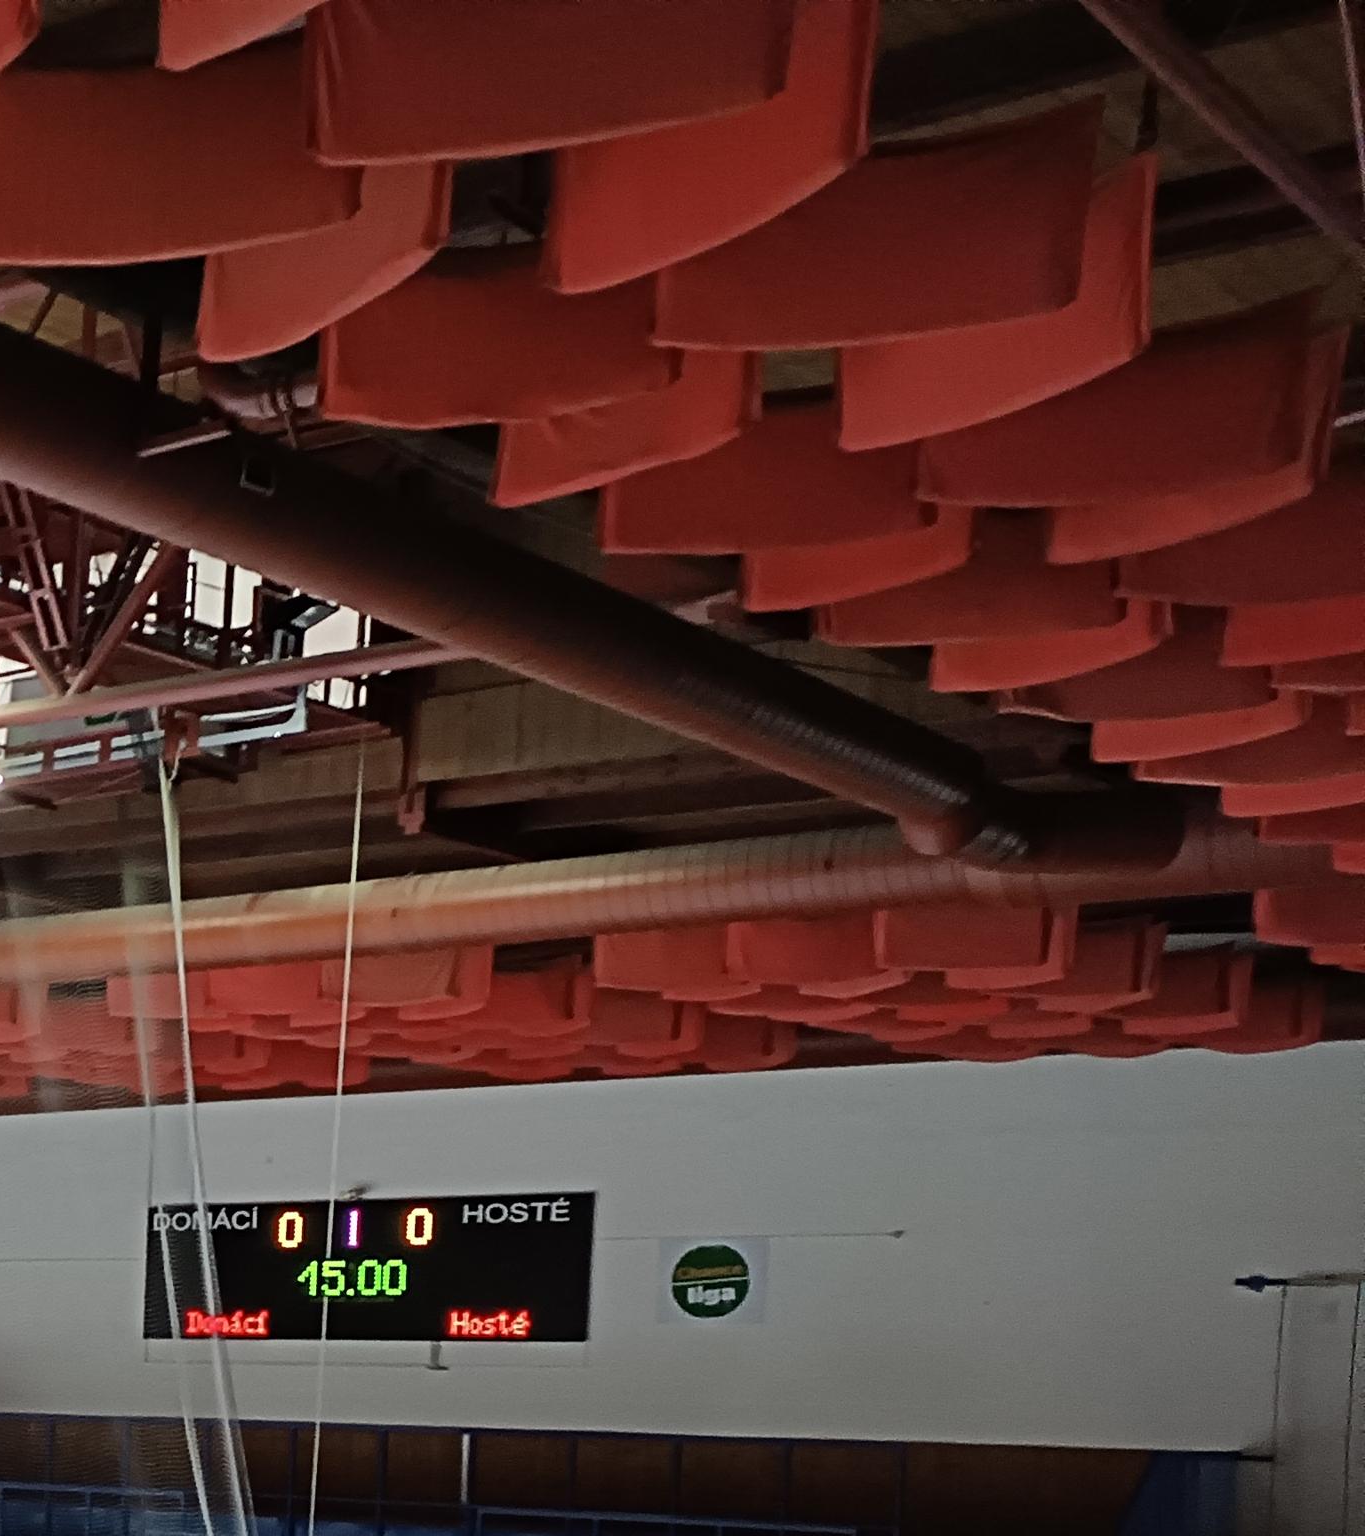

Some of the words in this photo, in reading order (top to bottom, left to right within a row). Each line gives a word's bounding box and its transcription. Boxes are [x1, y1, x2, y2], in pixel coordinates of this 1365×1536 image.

[461, 1197, 571, 1224] HOSTÉ
[277, 1211, 304, 1249] 0
[347, 1209, 360, 1247] 1
[405, 1207, 434, 1246] 0
[448, 1309, 531, 1336] Hosté
